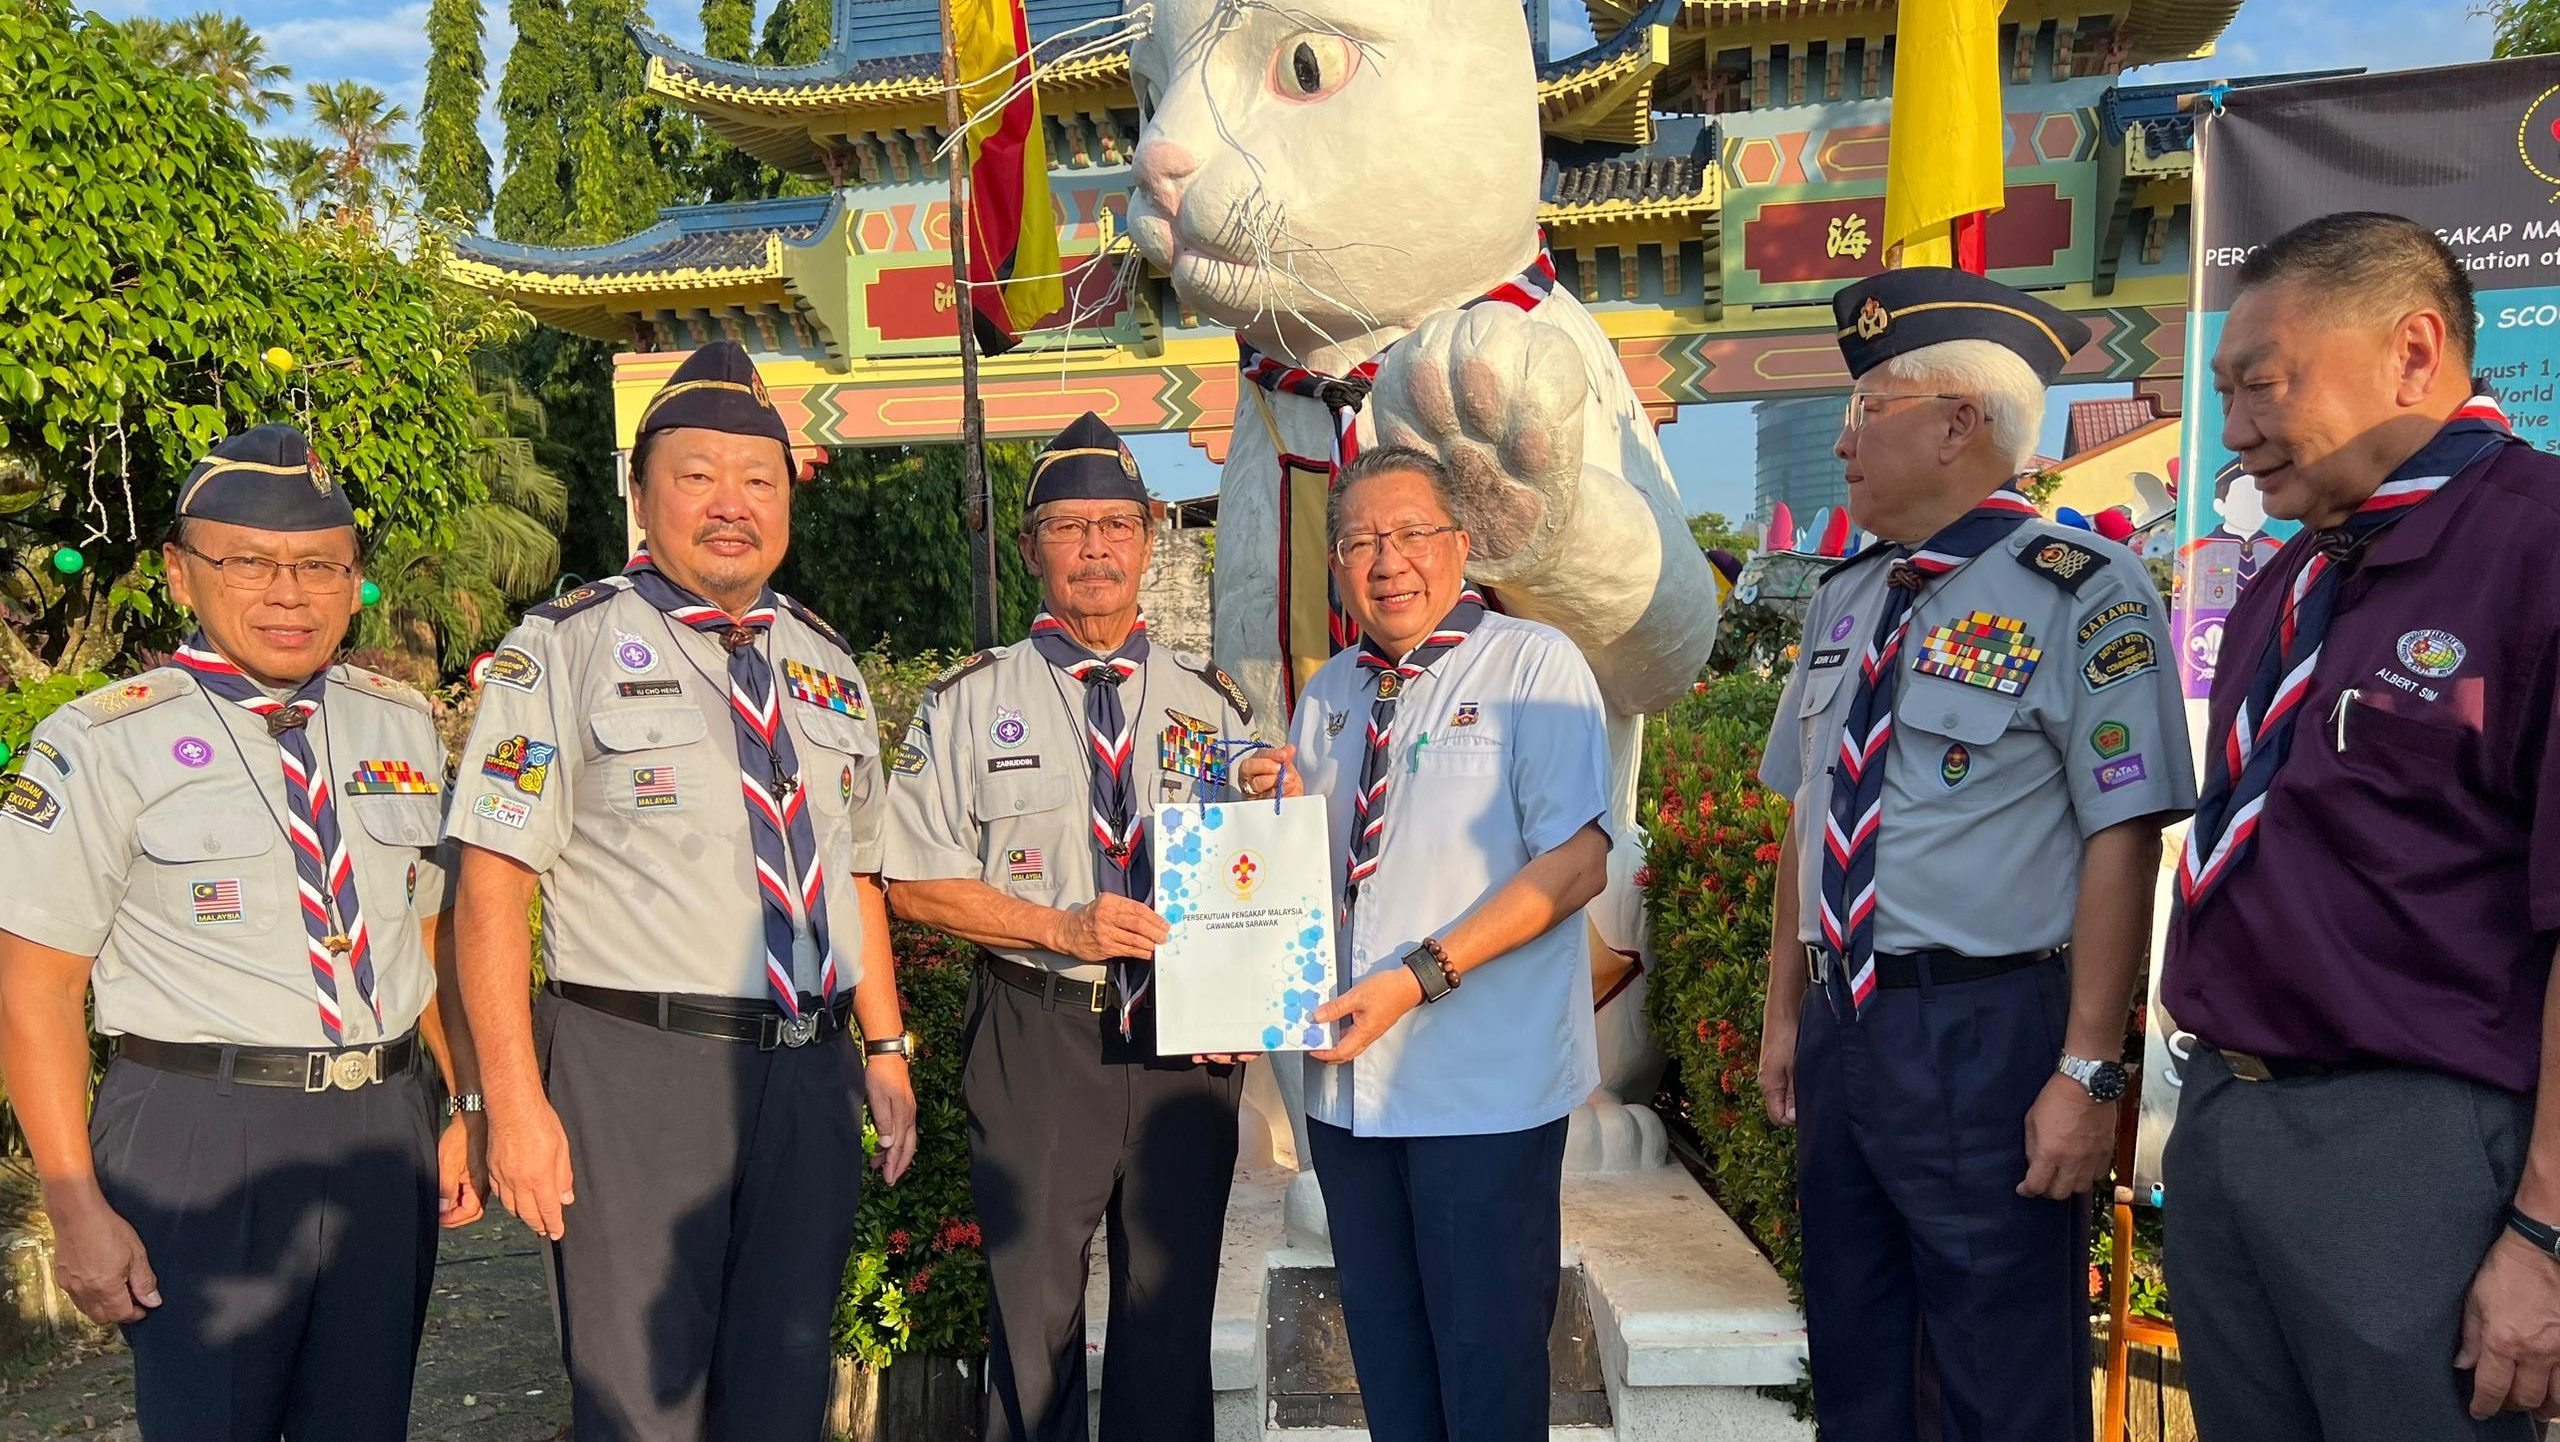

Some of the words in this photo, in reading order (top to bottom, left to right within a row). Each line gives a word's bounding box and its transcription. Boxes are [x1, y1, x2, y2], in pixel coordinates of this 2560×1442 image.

[1826, 213, 1872, 260] 海
[2080, 602, 2144, 639] SARAWAK
[2098, 640, 2123, 660] DEPUTY
[2375, 668, 2419, 692] ALBERT
[2419, 687, 2439, 701] SIM
[995, 758, 1033, 768] ZAINUDDIN
[638, 796, 676, 806] MALAYSIA
[496, 810, 525, 826] CMT
[198, 912, 241, 922] MALAYSIA
[1182, 911, 1230, 921] PERSEKUTUAN
[1231, 909, 1267, 918] PENGAKAP
[1267, 907, 1304, 916] MALAYSIA
[1205, 921, 1244, 931] CAWANGAN
[1245, 919, 1279, 929] SARAWAK
